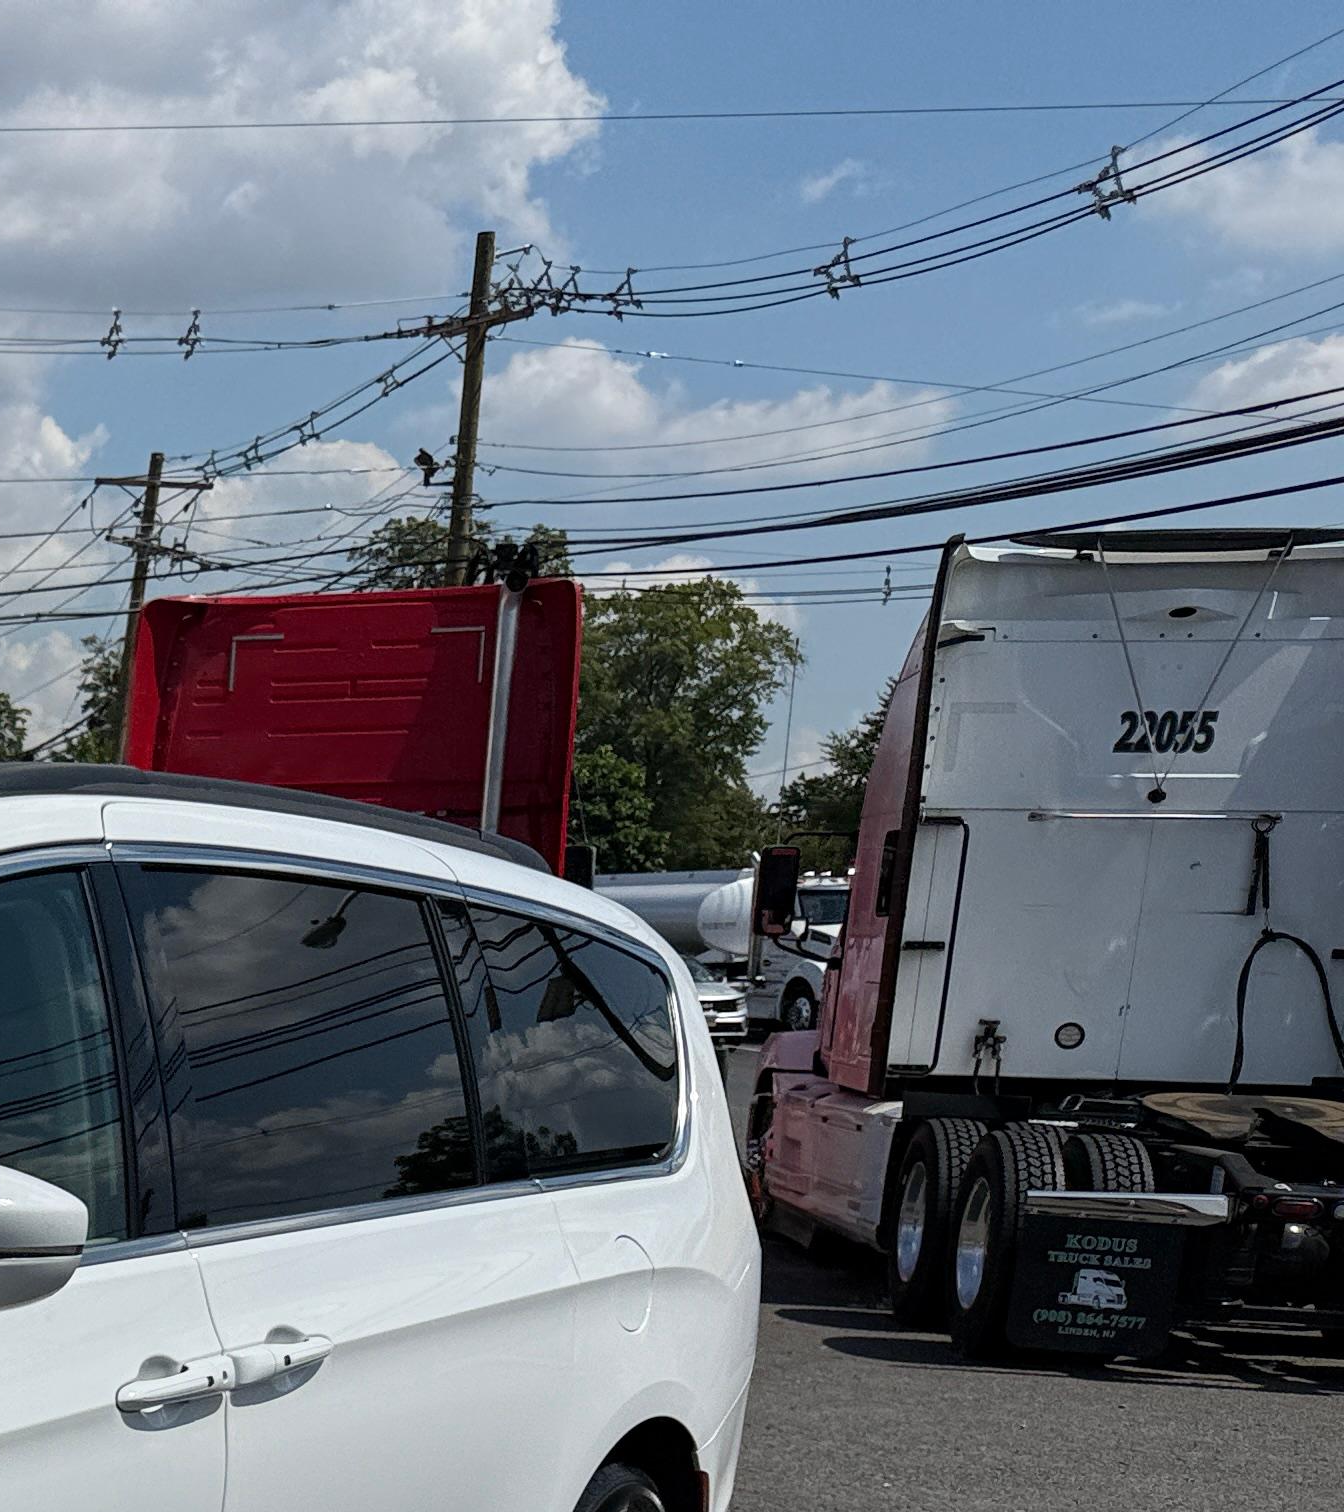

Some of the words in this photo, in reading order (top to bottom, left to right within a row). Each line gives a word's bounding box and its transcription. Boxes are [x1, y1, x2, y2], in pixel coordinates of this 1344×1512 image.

[1112, 710, 1220, 754] 22055
[1064, 1233, 1138, 1253] KODUS
[1047, 1250, 1101, 1266] TRUCK
[1103, 1255, 1152, 1269] SALES
[1057, 1326, 1100, 1338] LINDEN,
[1102, 1329, 1116, 1338] NJ
